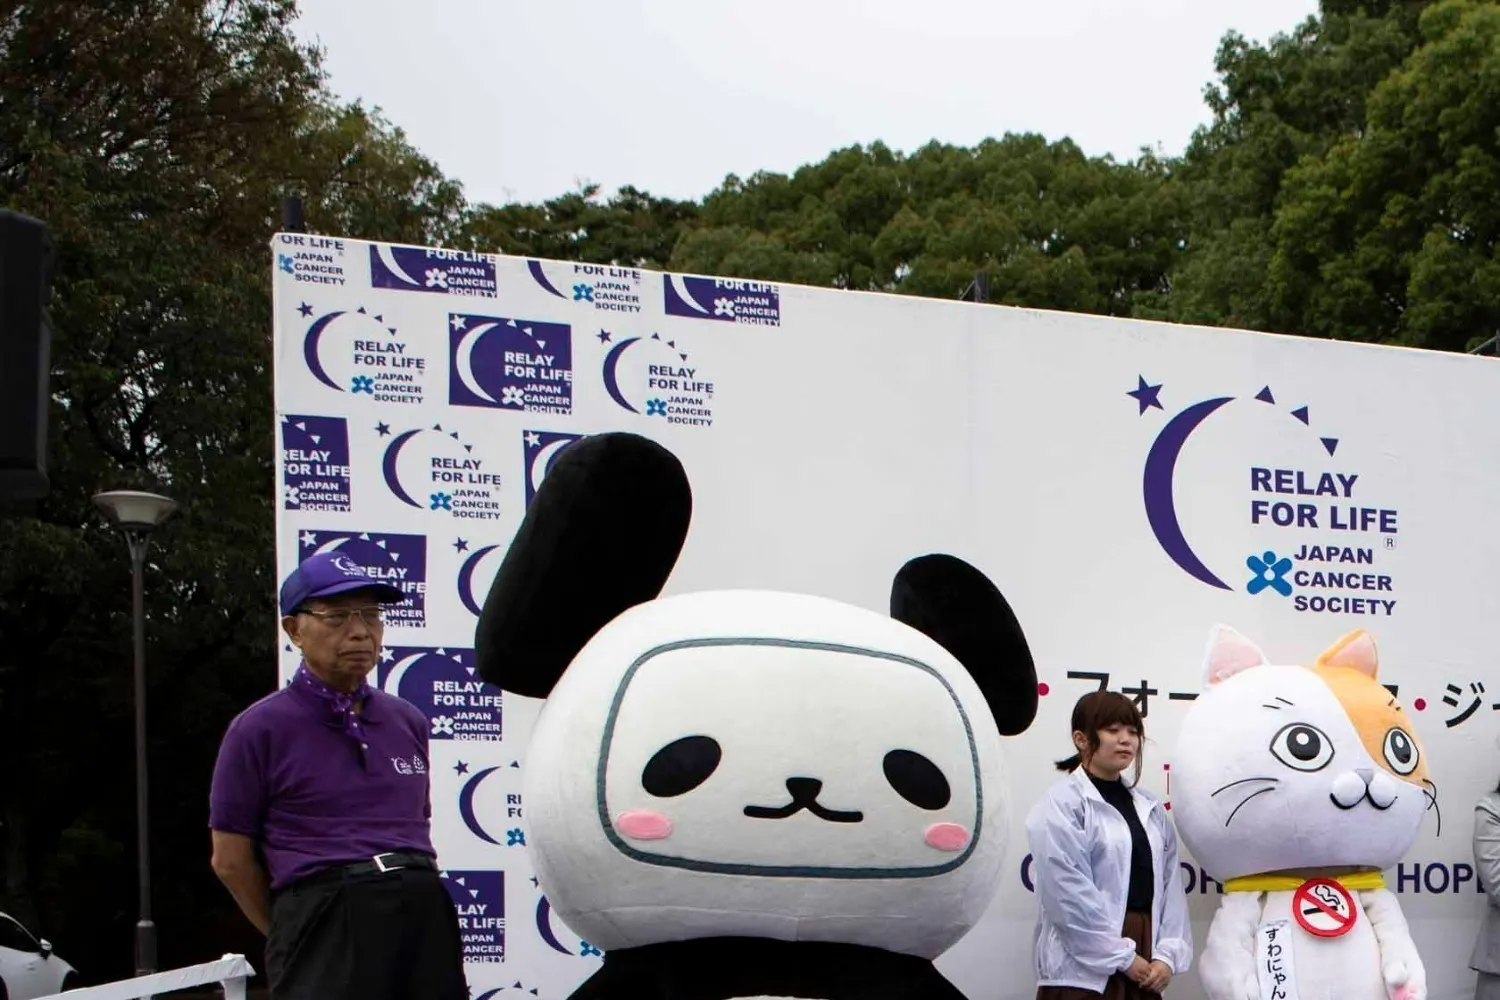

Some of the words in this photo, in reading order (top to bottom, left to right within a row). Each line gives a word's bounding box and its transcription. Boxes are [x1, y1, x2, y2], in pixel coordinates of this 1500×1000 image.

[282, 235, 304, 246] OR
[310, 238, 344, 250] LIFE
[294, 252, 333, 263] JAPAN
[426, 250, 460, 260] FOR
[463, 253, 496, 264] LIFE
[295, 264, 343, 275] CANCER
[447, 266, 485, 276] JAPAN
[574, 266, 604, 276] FOR
[610, 268, 640, 279] LIFE
[295, 274, 345, 285] SOCIETY
[448, 278, 494, 288] CANCER
[595, 282, 630, 291] JAPAN
[715, 280, 745, 290] FOR
[750, 282, 779, 293] LIFE
[448, 288, 497, 298] SOCIETY
[595, 292, 639, 302] CANCER
[734, 296, 769, 306] JAPAN
[595, 302, 640, 312] SOCIETY
[734, 306, 778, 316] CANCER
[735, 316, 780, 326] SOCIETY
[354, 340, 406, 354] RELAY
[354, 355, 386, 367] FOR
[392, 357, 425, 369] LIFE
[505, 352, 554, 366] RELAY
[505, 366, 536, 378] FOR
[541, 368, 572, 381] LIFE
[649, 365, 696, 378] RELAY
[375, 372, 413, 382] JAPAN
[374, 384, 422, 393] CANCER
[525, 384, 561, 394] JAPAN
[649, 378, 678, 390] FOR
[683, 382, 714, 393] LIFE
[374, 394, 422, 403] SOCIETY
[524, 394, 570, 404] CANCER
[668, 396, 702, 405] JAPAN
[524, 404, 572, 414] SOCIETY
[668, 406, 711, 416] CANCER
[668, 416, 713, 426] SOCIETY
[432, 458, 481, 470] RELAY
[318, 466, 350, 477] LIFE
[432, 471, 465, 482] FOR
[469, 474, 501, 485] LIFE
[1251, 468, 1358, 498] RELAY
[300, 482, 338, 490] JAPAN
[300, 492, 348, 501] CANCER
[300, 502, 350, 511] SOCIETY
[452, 500, 499, 509] CANCER
[453, 510, 500, 519] SOCIETY
[1252, 500, 1318, 528] FOR
[1330, 506, 1397, 533] LIFE
[1294, 545, 1373, 564] JAPAN
[1294, 571, 1392, 591] CANCER
[393, 582, 426, 593] IFE
[1294, 596, 1396, 616] SOCIETY
[434, 681, 484, 693] RELAY
[434, 695, 465, 706] FOR
[470, 696, 502, 707] LIFE
[454, 712, 491, 720] JAPAN
[453, 723, 500, 731] CANCER
[454, 733, 502, 742] SOCIETY
[454, 904, 487, 915] LAY
[474, 919, 505, 929] LIFE
[463, 945, 503, 953] ANCER
[463, 955, 505, 963] OCIETY
[1266, 928, 1286, 1000] すわにゃん
